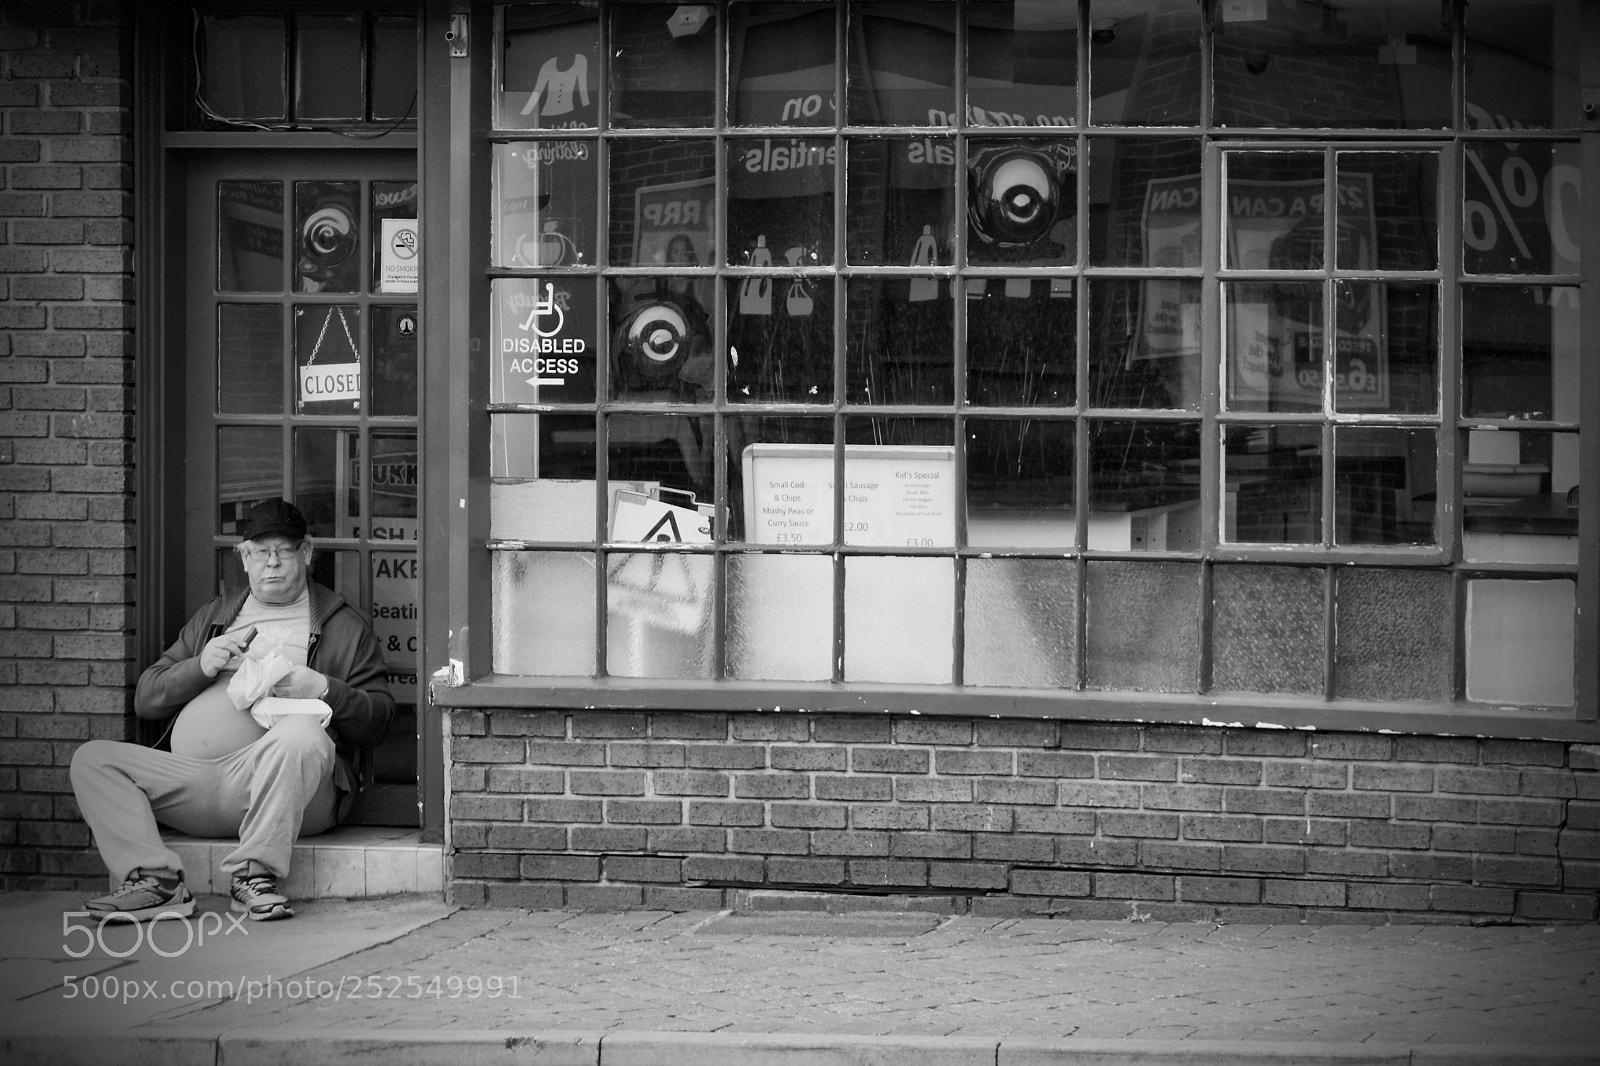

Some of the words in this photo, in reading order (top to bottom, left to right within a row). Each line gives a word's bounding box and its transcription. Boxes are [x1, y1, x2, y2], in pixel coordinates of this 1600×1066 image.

[503, 338, 585, 353] DISABLED
[509, 358, 579, 374] ACCESS
[913, 471, 940, 480] Special
[769, 481, 789, 489] Small
[790, 481, 805, 489] Cod
[849, 482, 880, 491] Sausage
[774, 494, 780, 502] &
[781, 494, 802, 503] Chips
[847, 494, 869, 503] Chips
[762, 507, 787, 516] Mushy
[788, 507, 805, 515] Peas
[767, 519, 787, 527] Curry
[788, 519, 810, 527] Sauce
[776, 533, 803, 543] £3.50
[906, 537, 934, 547] £300
[371, 557, 417, 579] AKE
